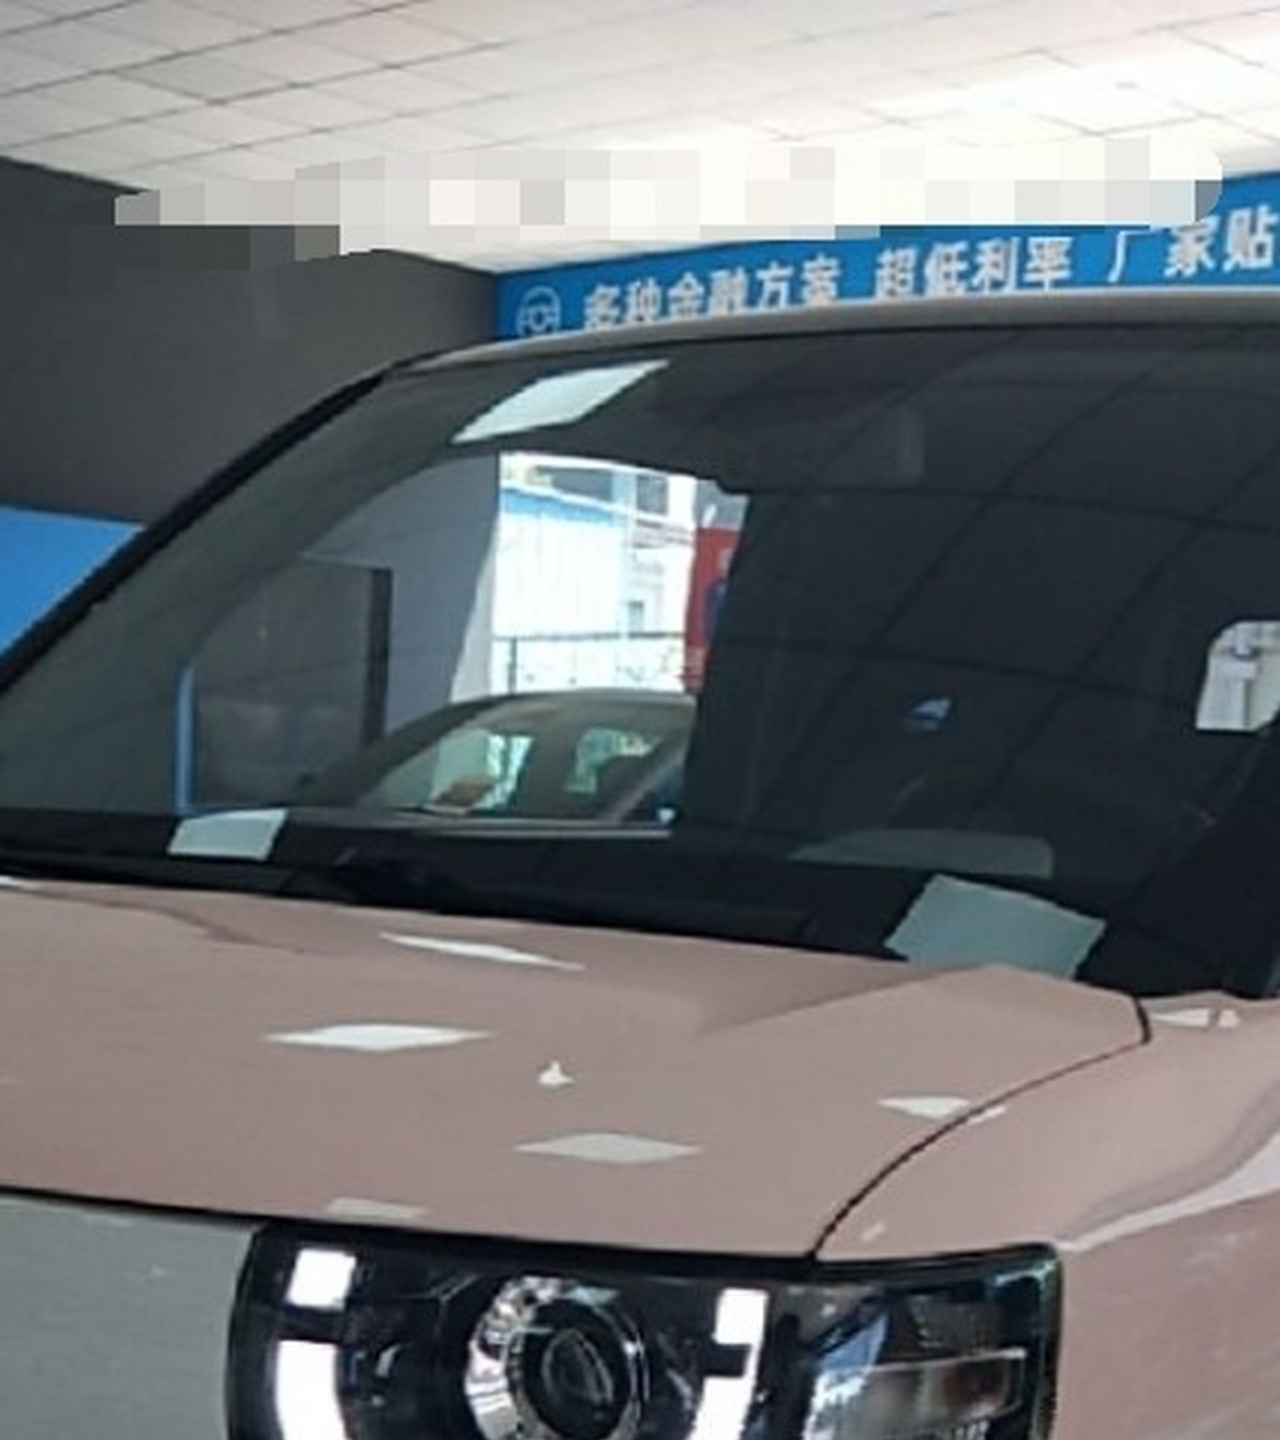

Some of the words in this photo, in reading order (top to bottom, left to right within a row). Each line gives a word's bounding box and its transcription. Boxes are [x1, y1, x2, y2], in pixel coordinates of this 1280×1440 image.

[583, 254, 839, 332] 多种金融方案
[875, 236, 1072, 300] 超低利率
